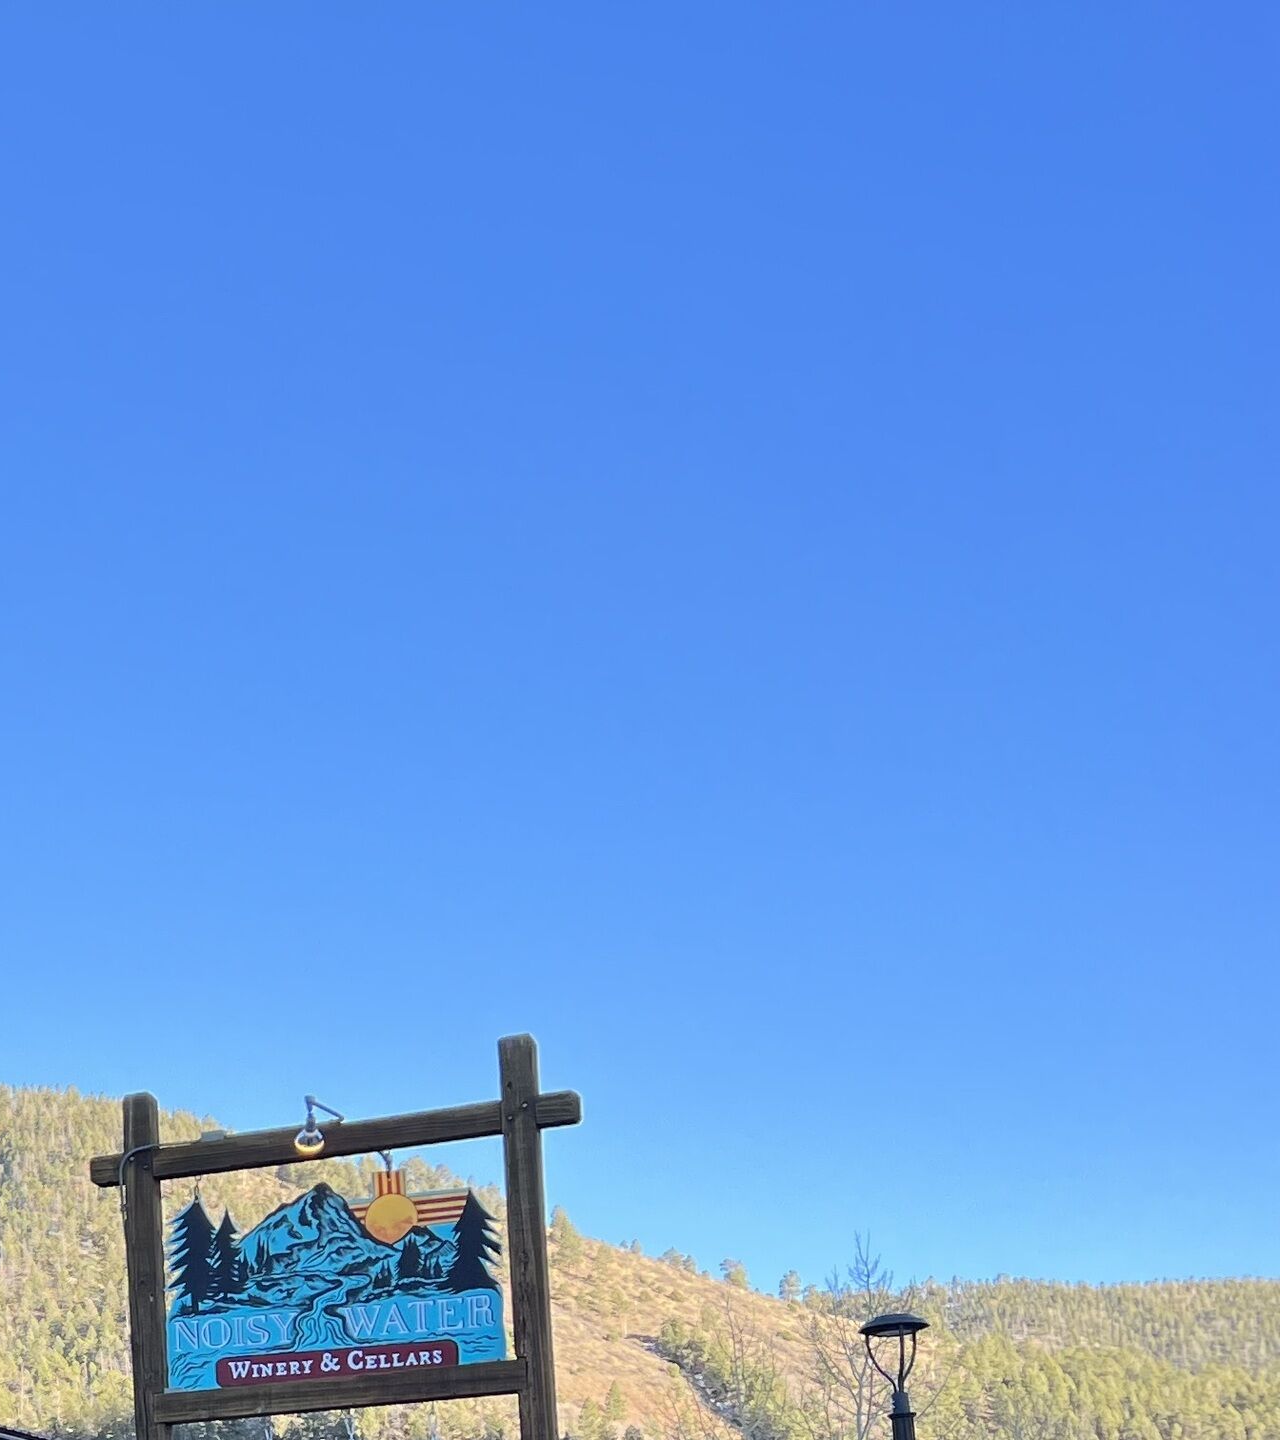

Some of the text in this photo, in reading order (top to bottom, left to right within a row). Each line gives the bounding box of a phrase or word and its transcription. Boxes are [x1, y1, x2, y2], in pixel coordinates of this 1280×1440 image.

[175, 1295, 495, 1351] NOISY WATER
[321, 1352, 340, 1371] &
